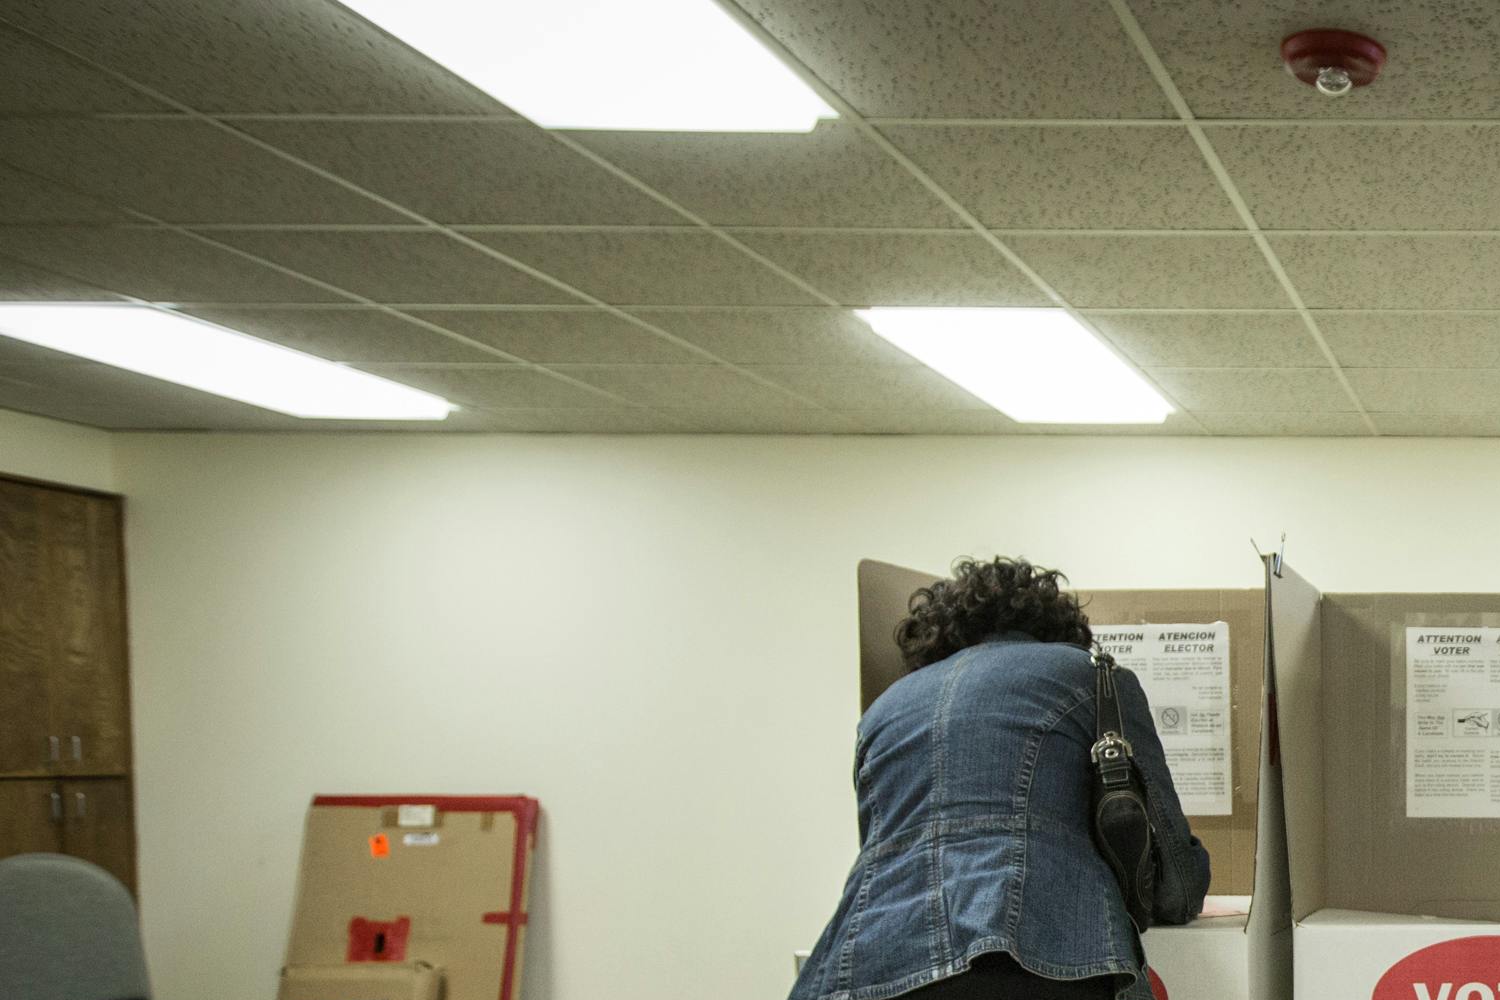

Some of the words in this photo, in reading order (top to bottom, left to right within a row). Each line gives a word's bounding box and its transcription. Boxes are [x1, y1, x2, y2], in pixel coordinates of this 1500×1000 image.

[1092, 633, 1144, 641] TENTION
[1158, 632, 1216, 641] ATENCION
[1417, 634, 1482, 643] ATTENTION
[1100, 644, 1133, 653] OTER
[1164, 644, 1215, 653] ELECTOR
[1433, 646, 1470, 655] VOTER
